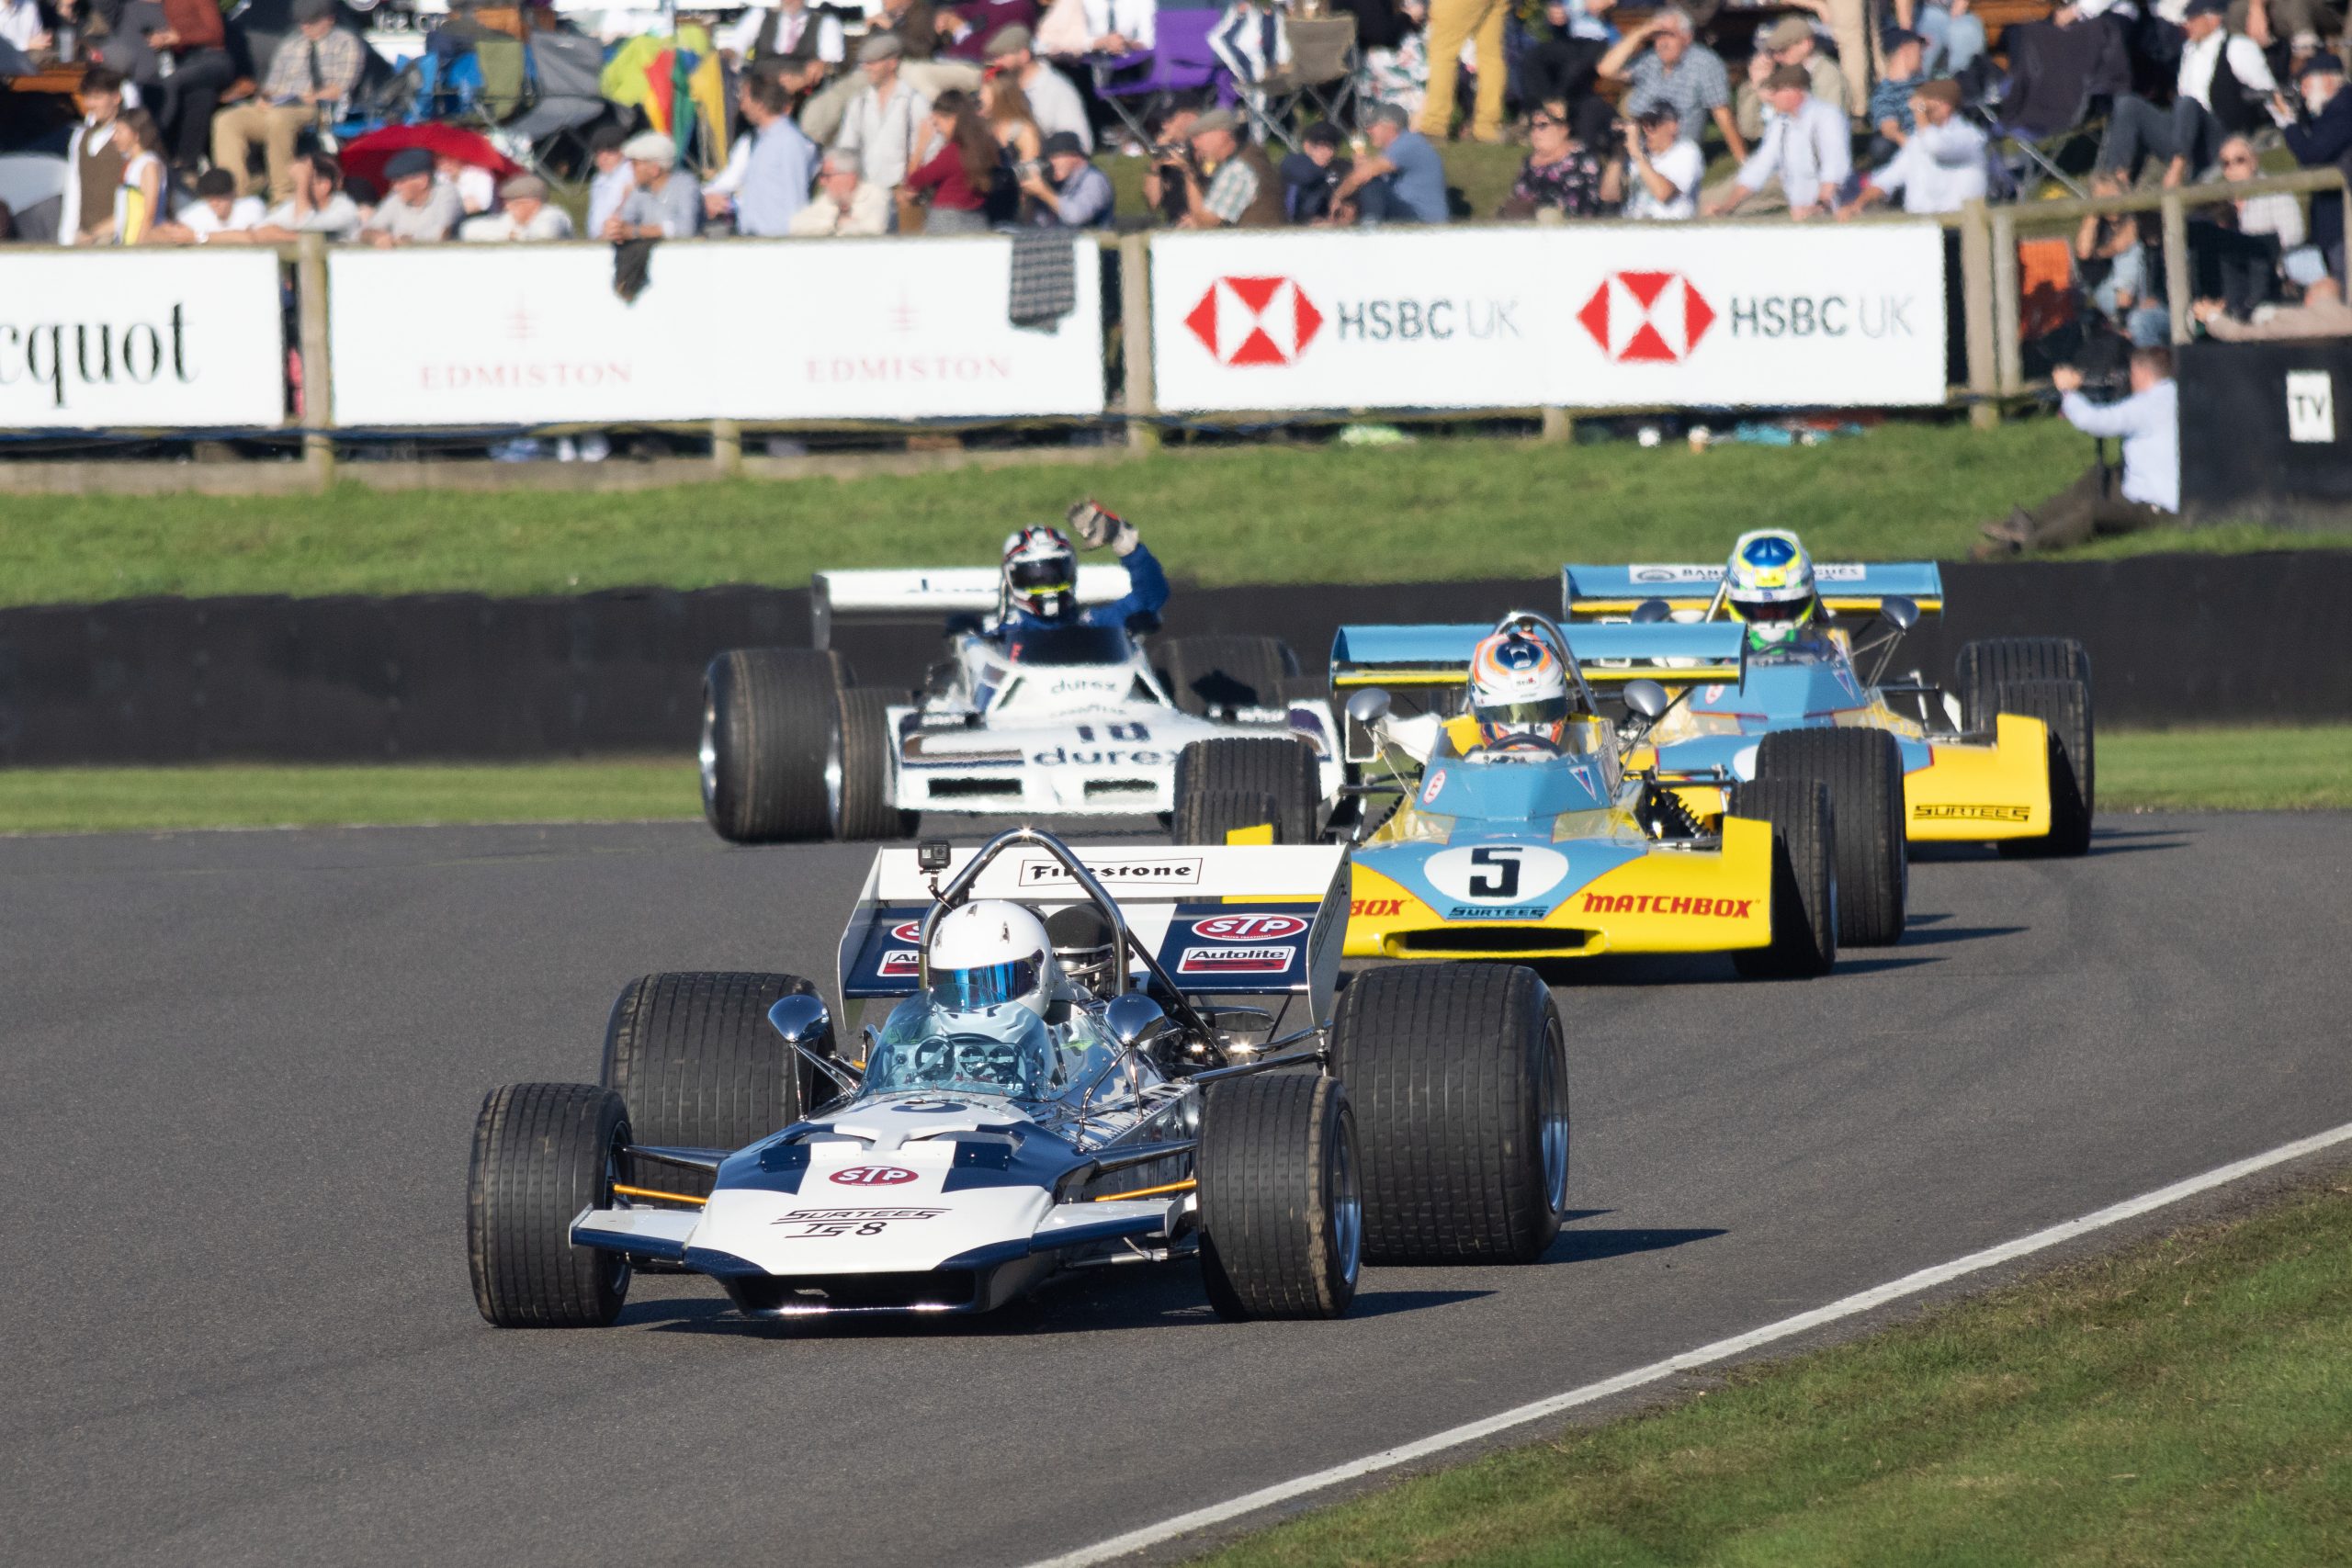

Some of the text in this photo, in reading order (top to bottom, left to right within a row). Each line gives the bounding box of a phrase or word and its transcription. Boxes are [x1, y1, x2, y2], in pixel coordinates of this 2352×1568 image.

[1337, 298, 1522, 341] HSBC UK
[1731, 295, 1914, 339] HSBC UK
[420, 361, 633, 390] EDMISTON
[807, 355, 1010, 384] EDMISTON
[2293, 394, 2326, 423] TV
[1051, 679, 1118, 694] durex
[1913, 805, 2030, 822] SURTEES
[1469, 847, 1523, 897] 5
[1447, 905, 1549, 920] SURTEES
[1206, 916, 1292, 935] STP
[1190, 950, 1284, 959] Autolite
[838, 1167, 908, 1183] STP
[773, 1207, 952, 1224] SURTEES
